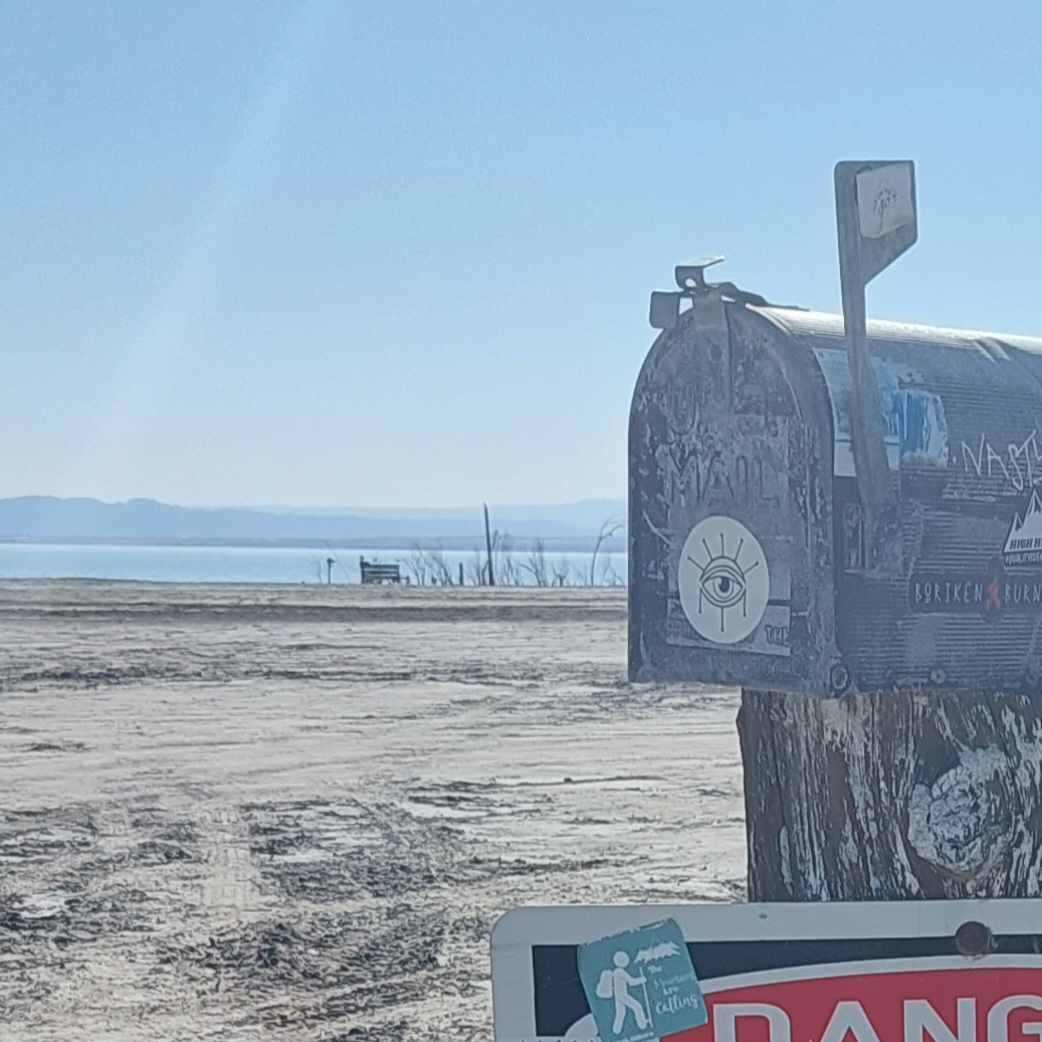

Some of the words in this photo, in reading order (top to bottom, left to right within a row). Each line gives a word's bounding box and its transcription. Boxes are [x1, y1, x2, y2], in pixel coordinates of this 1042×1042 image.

[660, 444, 780, 502] MAIL
[1010, 538, 1033, 549] HIGH
[915, 582, 984, 604] BORIKEN
[655, 994, 699, 1014] Calling
